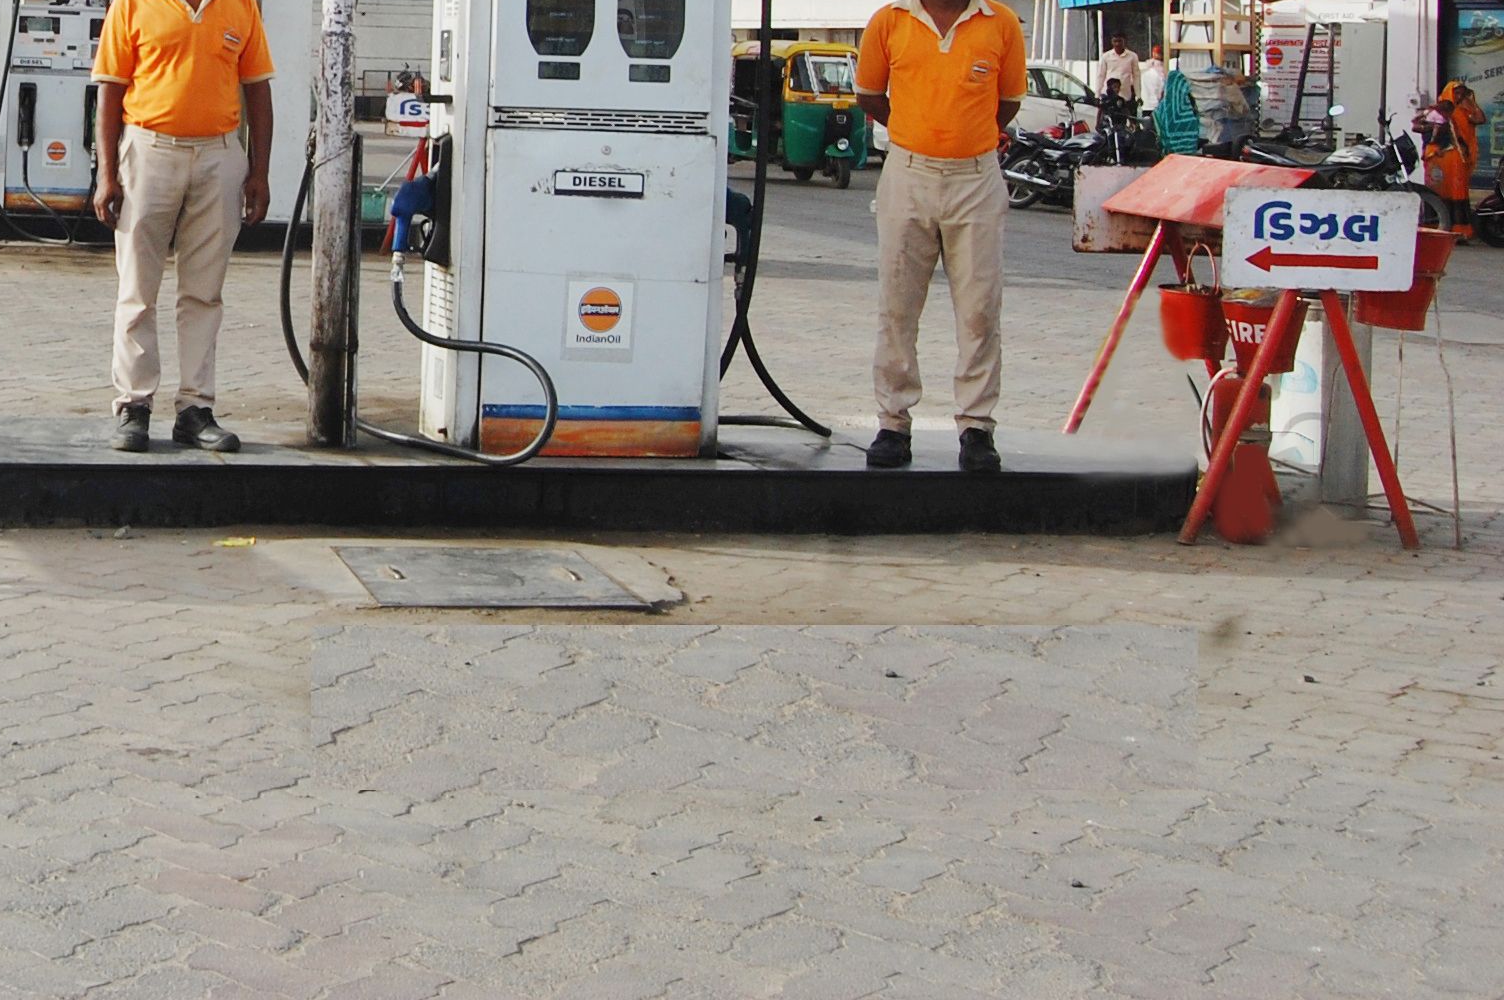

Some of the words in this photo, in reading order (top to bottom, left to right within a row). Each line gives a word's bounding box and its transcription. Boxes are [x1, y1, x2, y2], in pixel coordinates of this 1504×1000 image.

[573, 176, 626, 189] DIESEL
[1253, 200, 1379, 242] ડિઝલ
[575, 334, 621, 344] IndianOil
